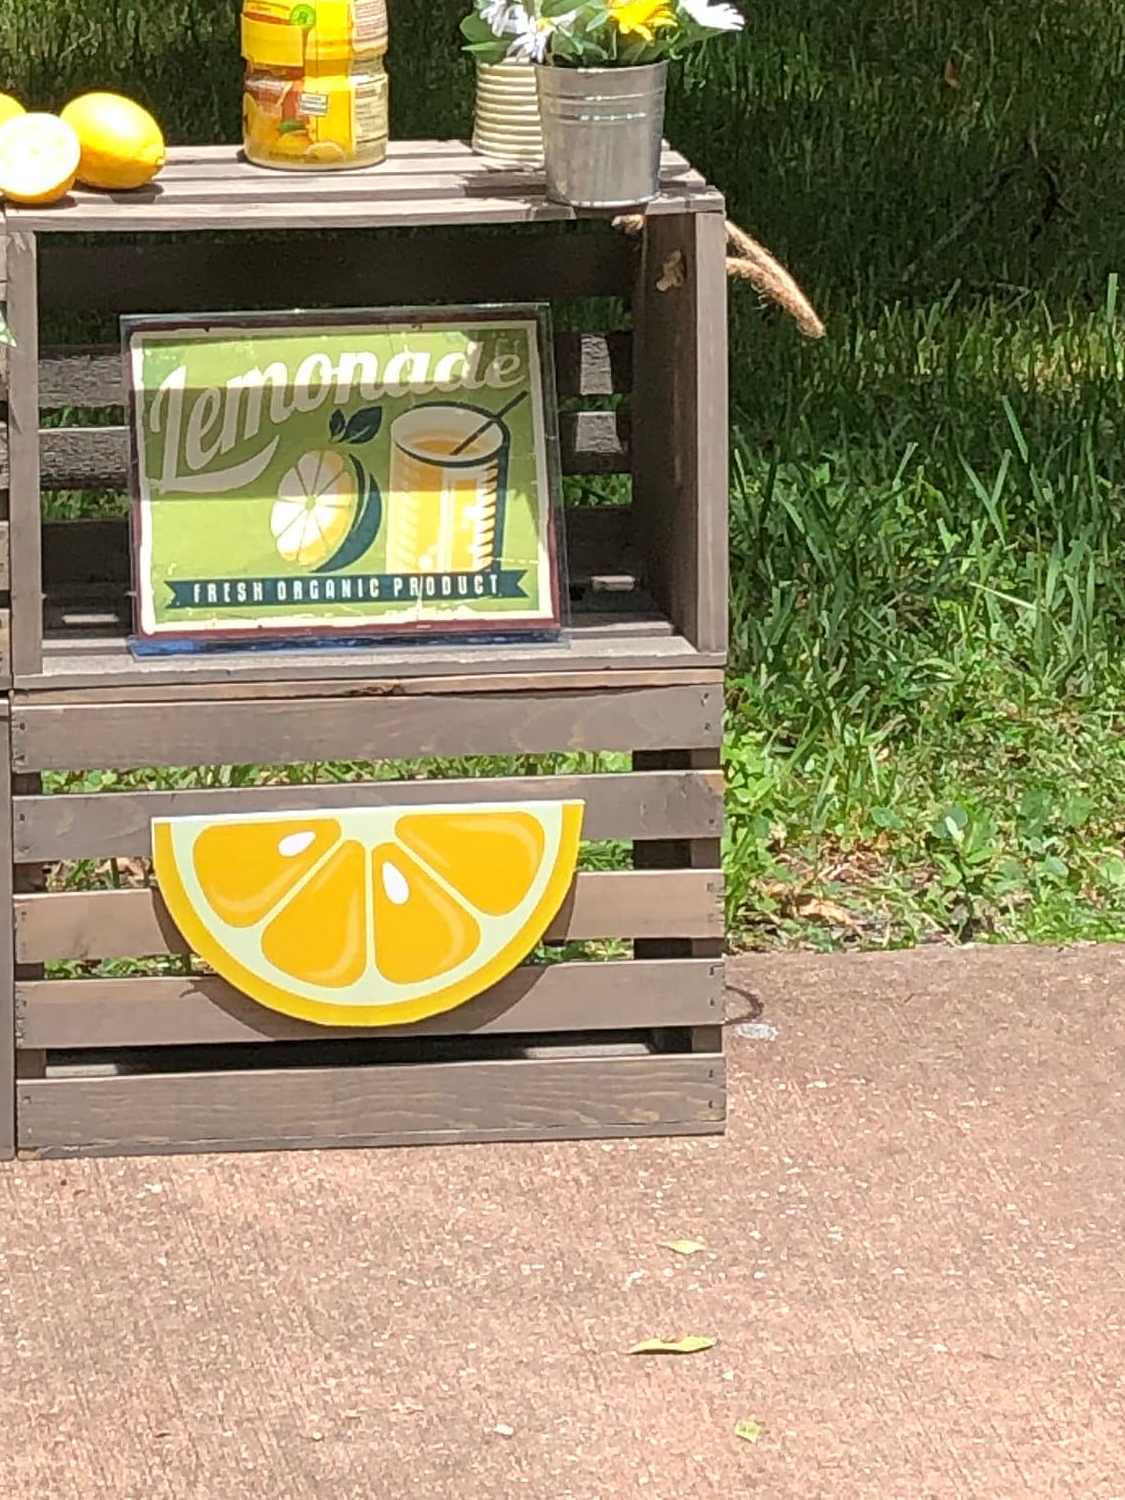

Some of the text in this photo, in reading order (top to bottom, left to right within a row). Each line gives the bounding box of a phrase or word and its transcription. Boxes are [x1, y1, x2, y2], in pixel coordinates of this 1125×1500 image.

[147, 338, 527, 493] Lemonade
[193, 573, 499, 603] FRESH ORGANIC PRODUCT
